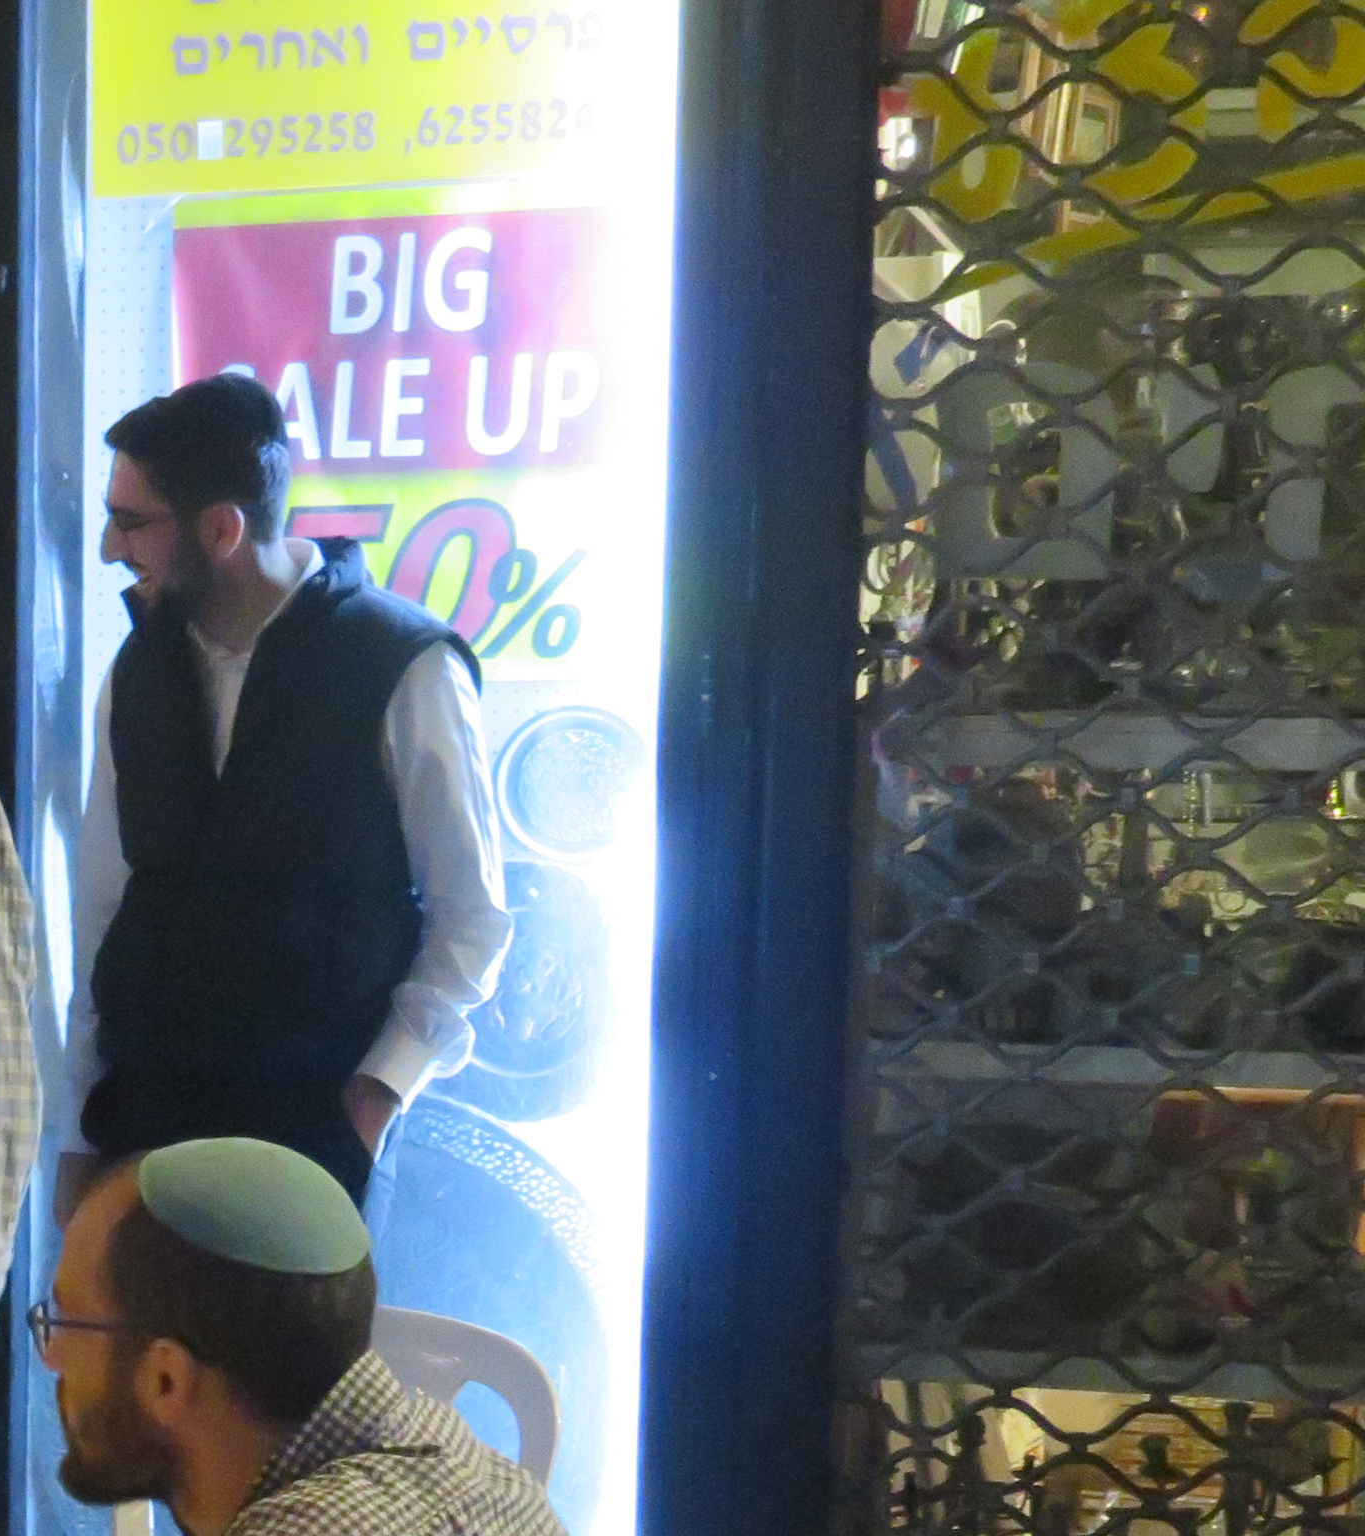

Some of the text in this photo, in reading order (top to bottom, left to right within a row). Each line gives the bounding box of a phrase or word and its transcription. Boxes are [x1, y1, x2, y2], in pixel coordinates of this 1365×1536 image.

[172, 11, 604, 76] פרסיים ואחרים
[328, 225, 494, 336] BIG
[215, 350, 601, 462] ALE UP
